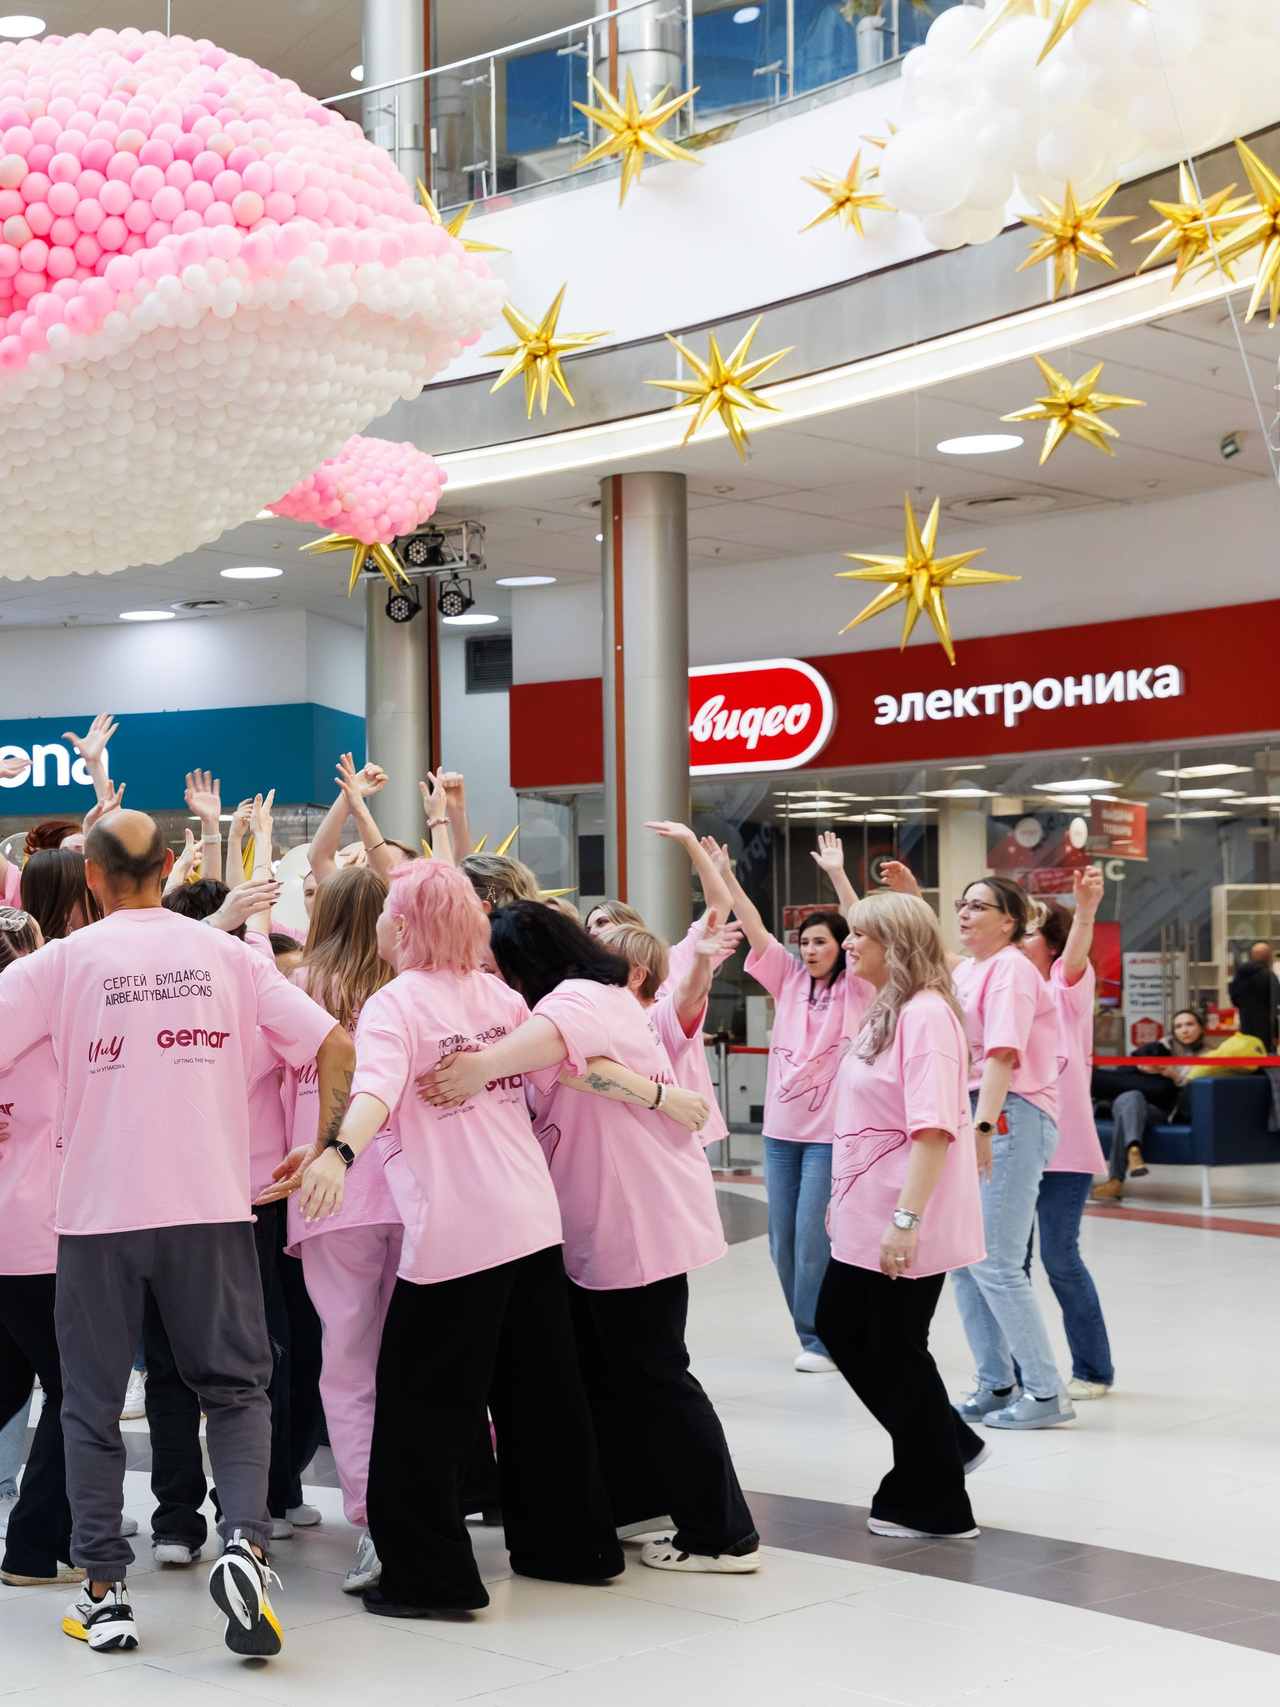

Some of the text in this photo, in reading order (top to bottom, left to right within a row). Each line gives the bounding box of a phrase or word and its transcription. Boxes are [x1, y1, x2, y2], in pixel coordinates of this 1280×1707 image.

[873, 664, 1181, 728] электроника
[103, 969, 212, 991] СЕРГЕЙ БУЛДАКОВ
[105, 984, 213, 1007] AIRBEAUTYBALLOONS
[157, 1028, 231, 1049] Gemar
